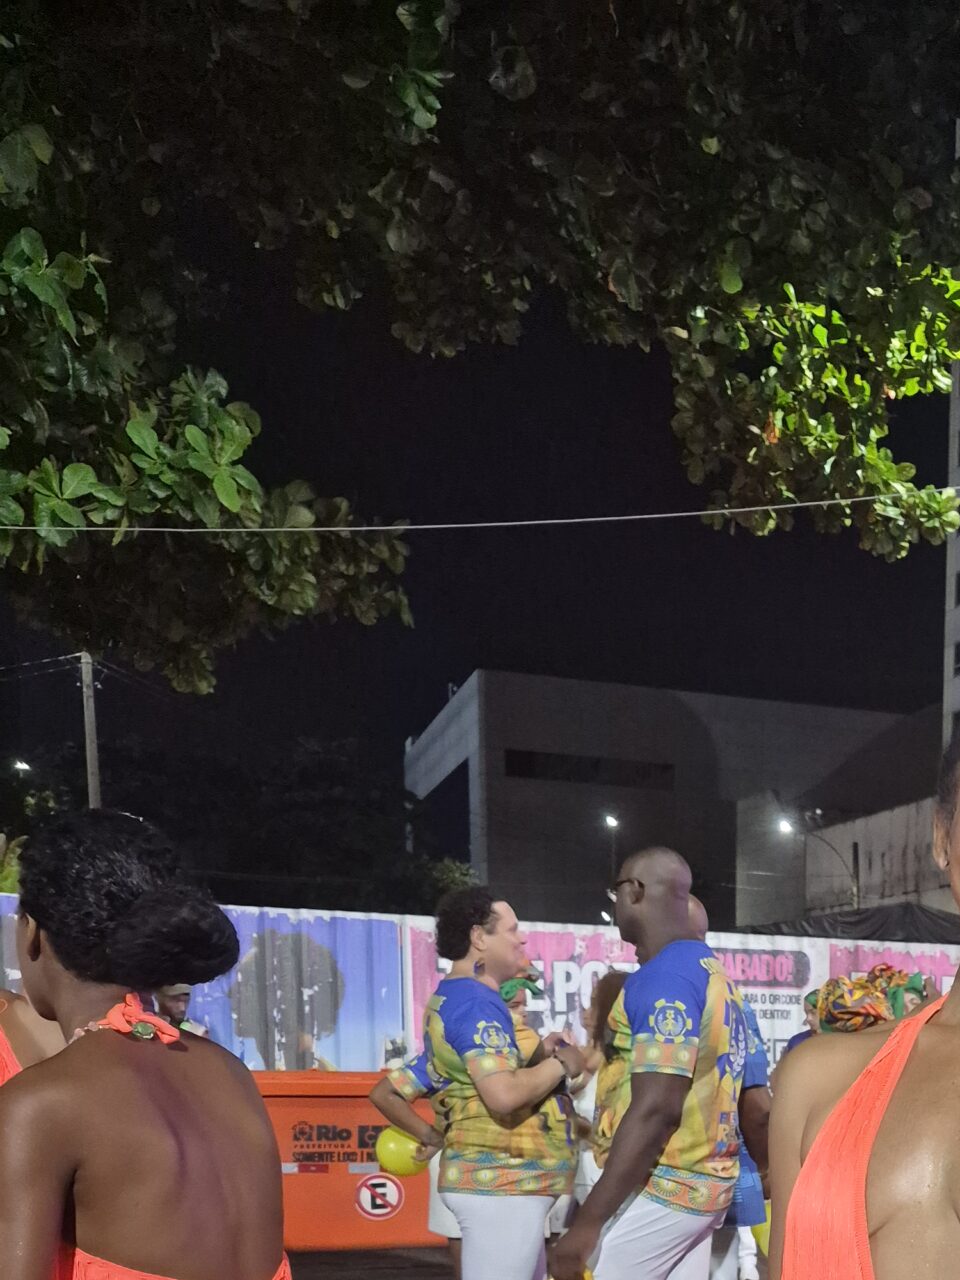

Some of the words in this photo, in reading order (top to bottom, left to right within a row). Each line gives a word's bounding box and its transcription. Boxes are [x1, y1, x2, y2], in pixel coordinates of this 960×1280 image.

[715, 952, 794, 982] ABADO!
[316, 1125, 352, 1142] Rio
[370, 1182, 389, 1210] E
